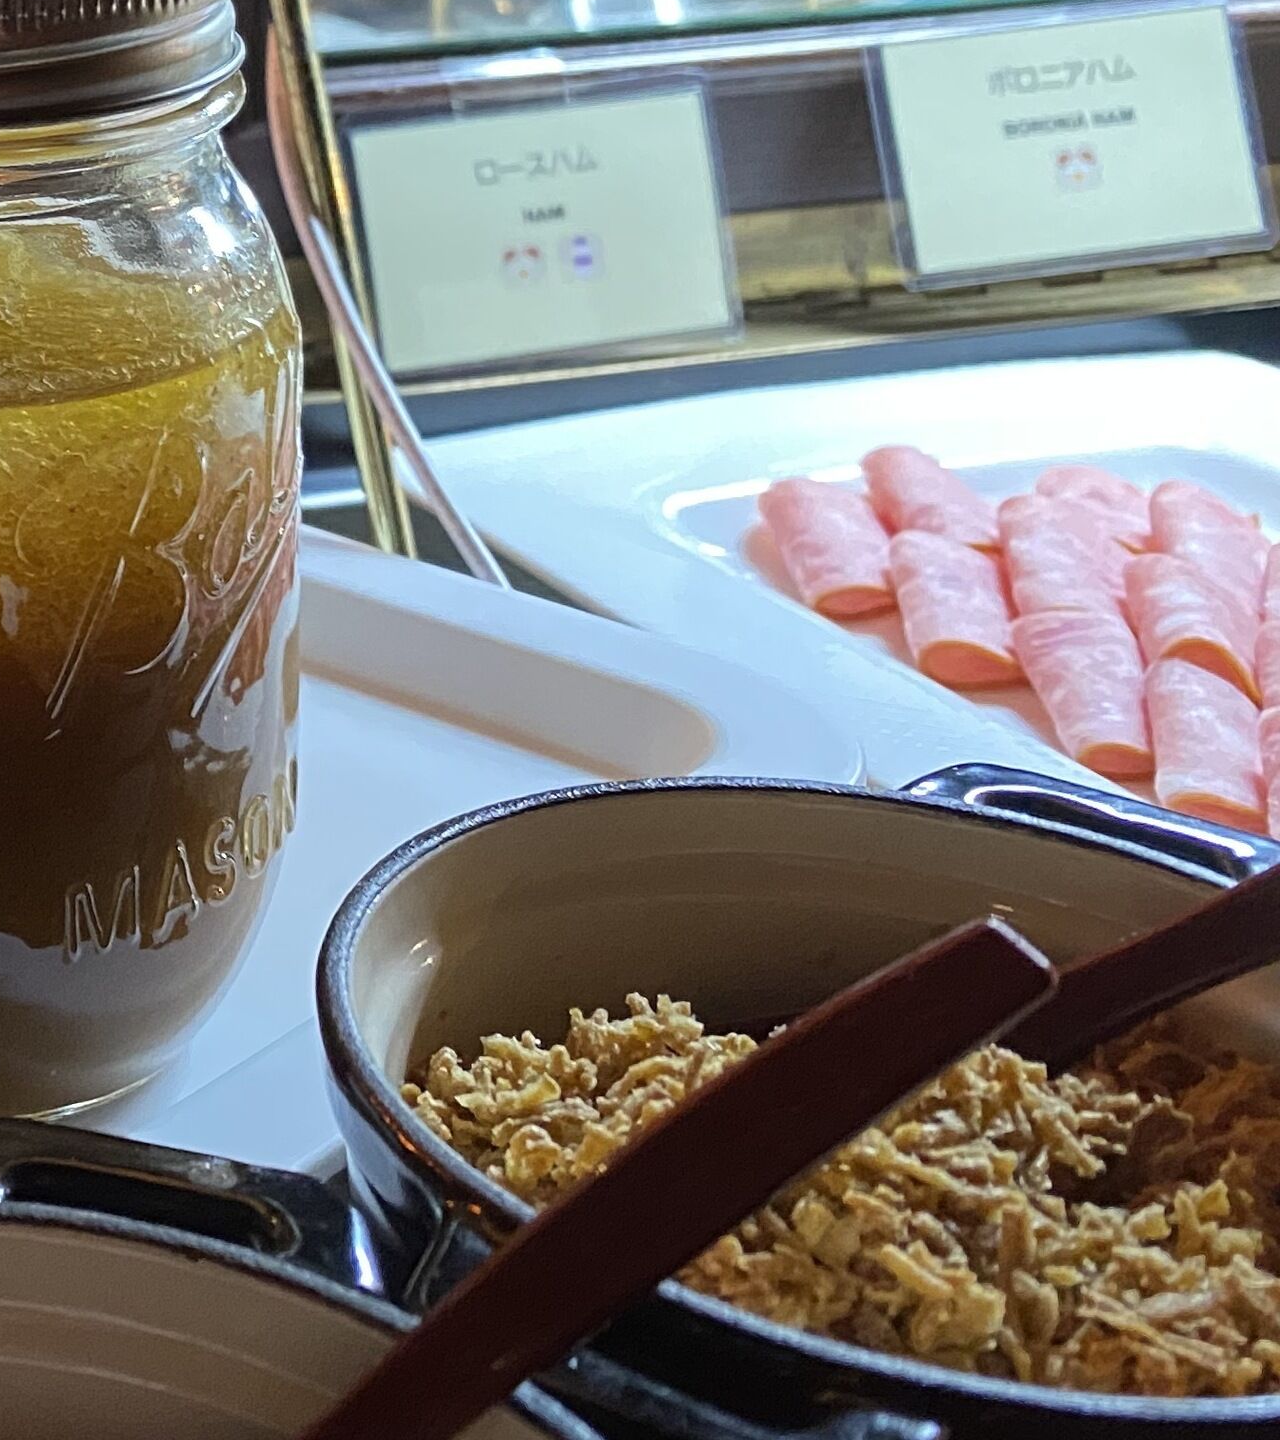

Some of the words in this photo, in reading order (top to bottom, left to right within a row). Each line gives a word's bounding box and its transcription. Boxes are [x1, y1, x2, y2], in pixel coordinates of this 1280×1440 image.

[474, 143, 598, 187] ロースハム
[62, 753, 299, 965] MASON
